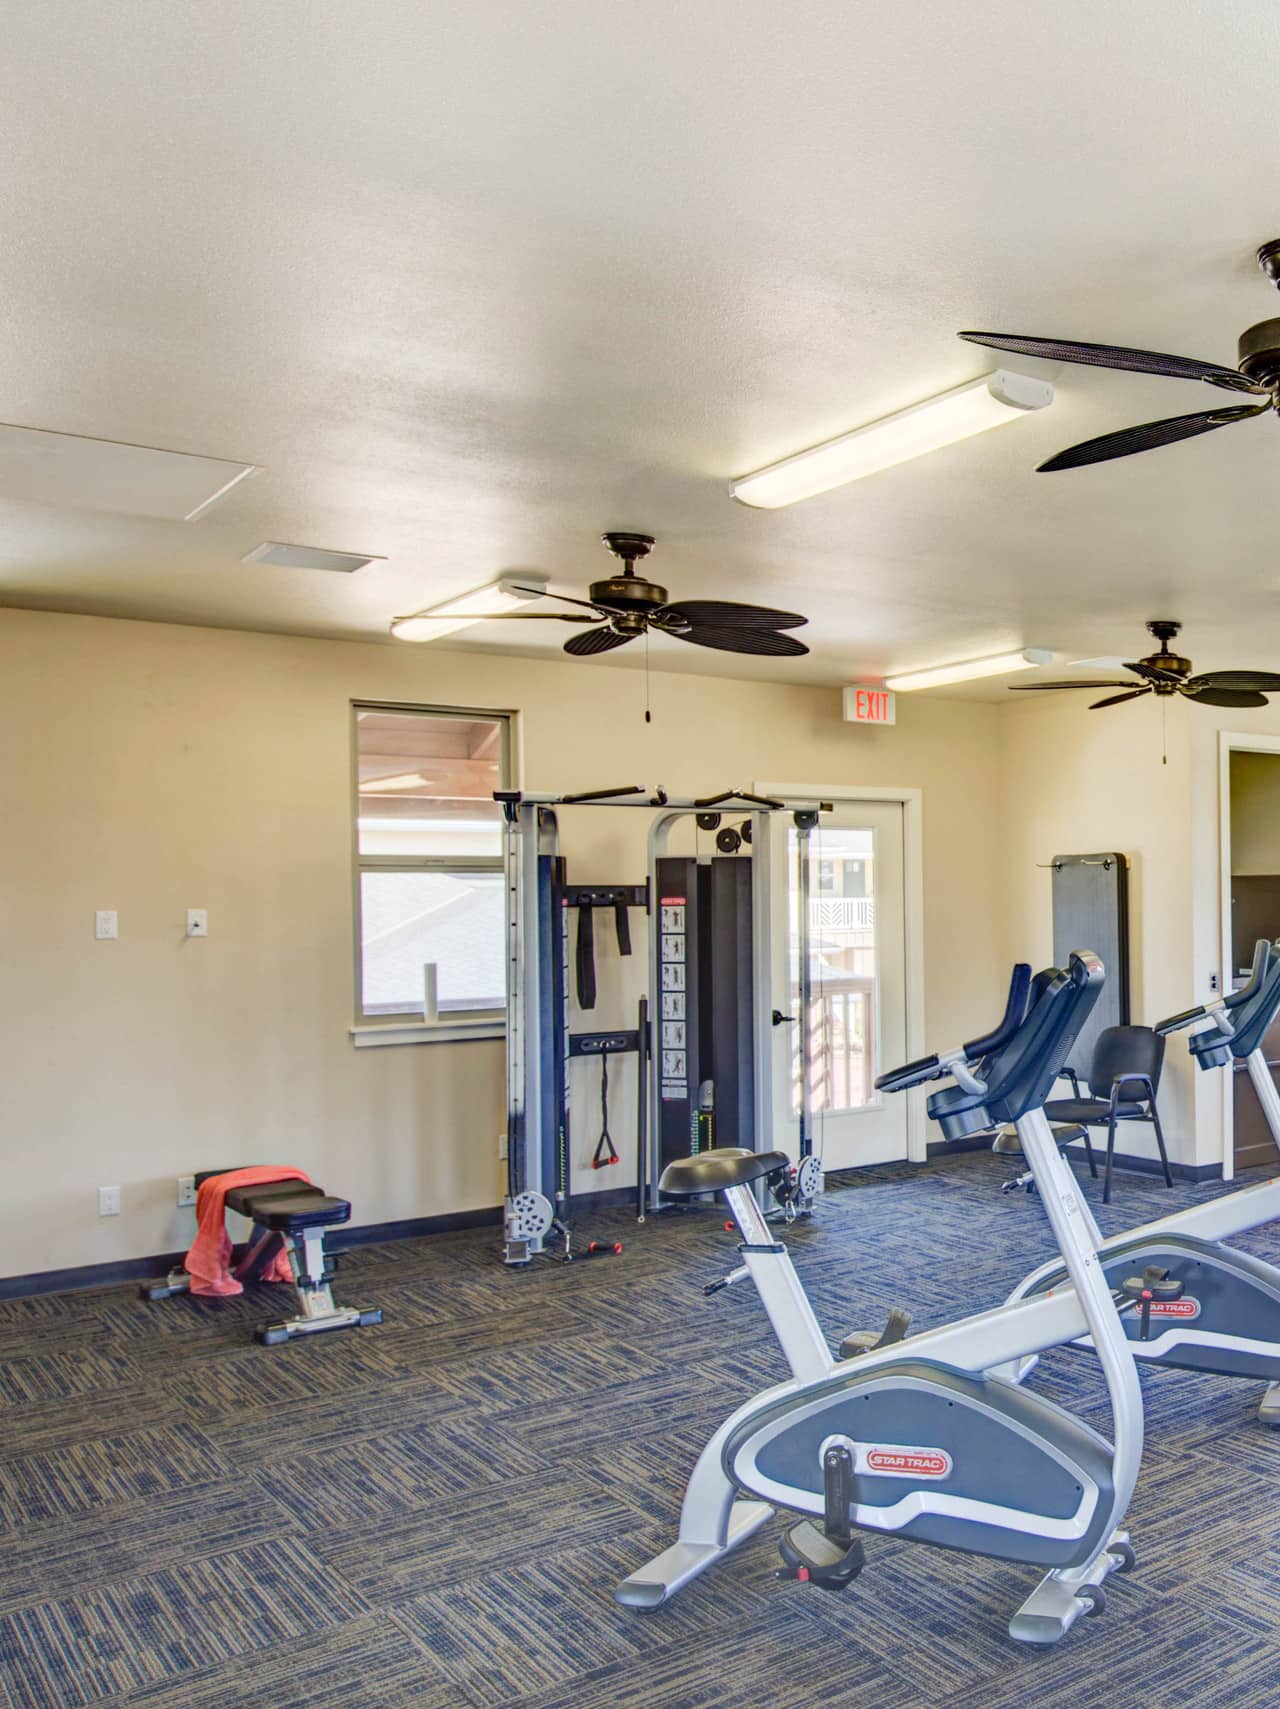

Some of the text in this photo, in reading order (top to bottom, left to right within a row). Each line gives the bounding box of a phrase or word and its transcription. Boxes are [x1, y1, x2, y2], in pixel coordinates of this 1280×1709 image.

[856, 690, 889, 720] EXIT
[1166, 1304, 1191, 1312] TRAC
[873, 1456, 941, 1468] STAR TRAC
